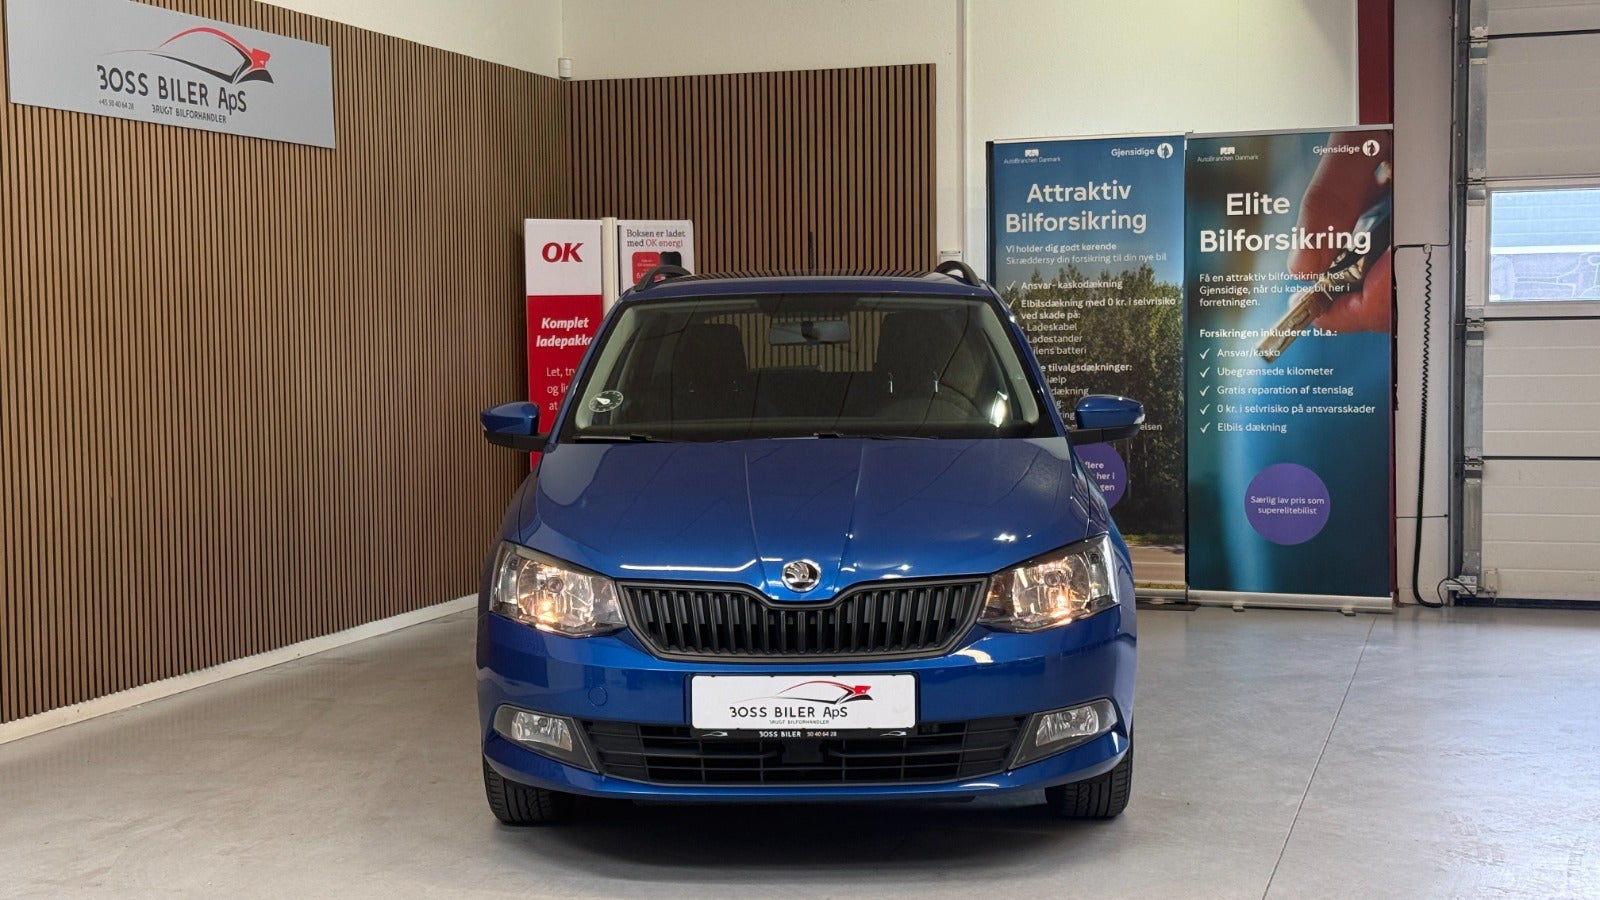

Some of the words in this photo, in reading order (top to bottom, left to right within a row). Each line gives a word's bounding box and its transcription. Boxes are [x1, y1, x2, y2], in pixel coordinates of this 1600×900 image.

[158, 76, 209, 106] BILER
[218, 86, 247, 115] ApS
[176, 107, 226, 124] BILFORHANDLER
[1111, 148, 1154, 158] Gjensidige
[1312, 145, 1360, 156] Gjensidige
[1026, 180, 1132, 203] Attraktiv
[1226, 192, 1290, 216] Elite
[1006, 210, 1147, 234] Bilforsikring
[627, 229, 654, 237] Boksen
[666, 229, 686, 237] ladet
[658, 240, 683, 249] energi
[1200, 226, 1371, 254] Bilforsikring
[542, 242, 584, 263] OK
[1006, 245, 1015, 253] Vi
[1016, 244, 1043, 253] holder
[1045, 244, 1058, 254] dig
[1060, 243, 1080, 254] godt
[1082, 242, 1117, 251] kørende
[1006, 256, 1054, 265] Skræddersy
[1057, 255, 1070, 264] din
[1072, 254, 1111, 264] forsikring
[1113, 253, 1122, 262] til
[1124, 253, 1136, 262] din
[1139, 254, 1154, 263] nye
[1156, 252, 1167, 261] bil
[1200, 273, 1210, 282] Få
[1226, 272, 1266, 282] attraktiv
[1268, 272, 1325, 282] bilforsikring
[1326, 271, 1344, 280] hos
[1058, 280, 1123, 290] kaskodækning
[1200, 286, 1251, 296] Gjensidige,
[1253, 284, 1267, 293] når
[1271, 285, 1283, 293] du
[1285, 284, 1312, 293] køber
[1314, 284, 1326, 292] bil
[1328, 283, 1344, 292] her
[1346, 283, 1350, 292] i
[1021, 299, 1083, 309] Elbilsdækning
[1085, 298, 1106, 307] med
[1115, 298, 1127, 306] kr.
[1133, 298, 1176, 306] selvrisiko
[1200, 298, 1260, 308] forretningen.
[1021, 311, 1038, 320] ved
[1039, 311, 1065, 320] skade
[1067, 311, 1080, 321] på:
[542, 316, 589, 331] Komplet
[1027, 323, 1077, 332] Ladeskabel
[1028, 335, 1083, 344] Ladestander
[1200, 329, 1259, 340] Forsikringen
[1260, 329, 1311, 338] inkluderer
[1313, 329, 1338, 337] bl.a.:
[1057, 346, 1086, 355] batteri
[1217, 349, 1280, 358] Ansvar/kasko
[546, 367, 563, 377] Let,
[1048, 363, 1132, 373] tilvalgsdækninger:
[1217, 368, 1284, 377] Ubegrænsede
[1287, 367, 1334, 376] kilometer
[547, 386, 559, 396] og
[1217, 386, 1246, 395] Gratis
[1248, 386, 1297, 396] reparation
[1300, 386, 1310, 394] af
[1312, 386, 1354, 396] stenslag
[549, 402, 558, 410] at
[1217, 405, 1223, 413] 0
[1225, 404, 1238, 413] kr.
[1245, 404, 1290, 413] selvrisiko
[1292, 404, 1303, 415] på
[1306, 404, 1376, 414] ansvarsskader
[1218, 423, 1243, 432] Elbils
[1246, 423, 1287, 433] dækning
[1250, 496, 1276, 505] Særlig
[1290, 496, 1306, 506] pris
[1258, 506, 1317, 515] superelitebilist
[775, 707, 815, 718] BILER
[823, 706, 848, 720] ApS
